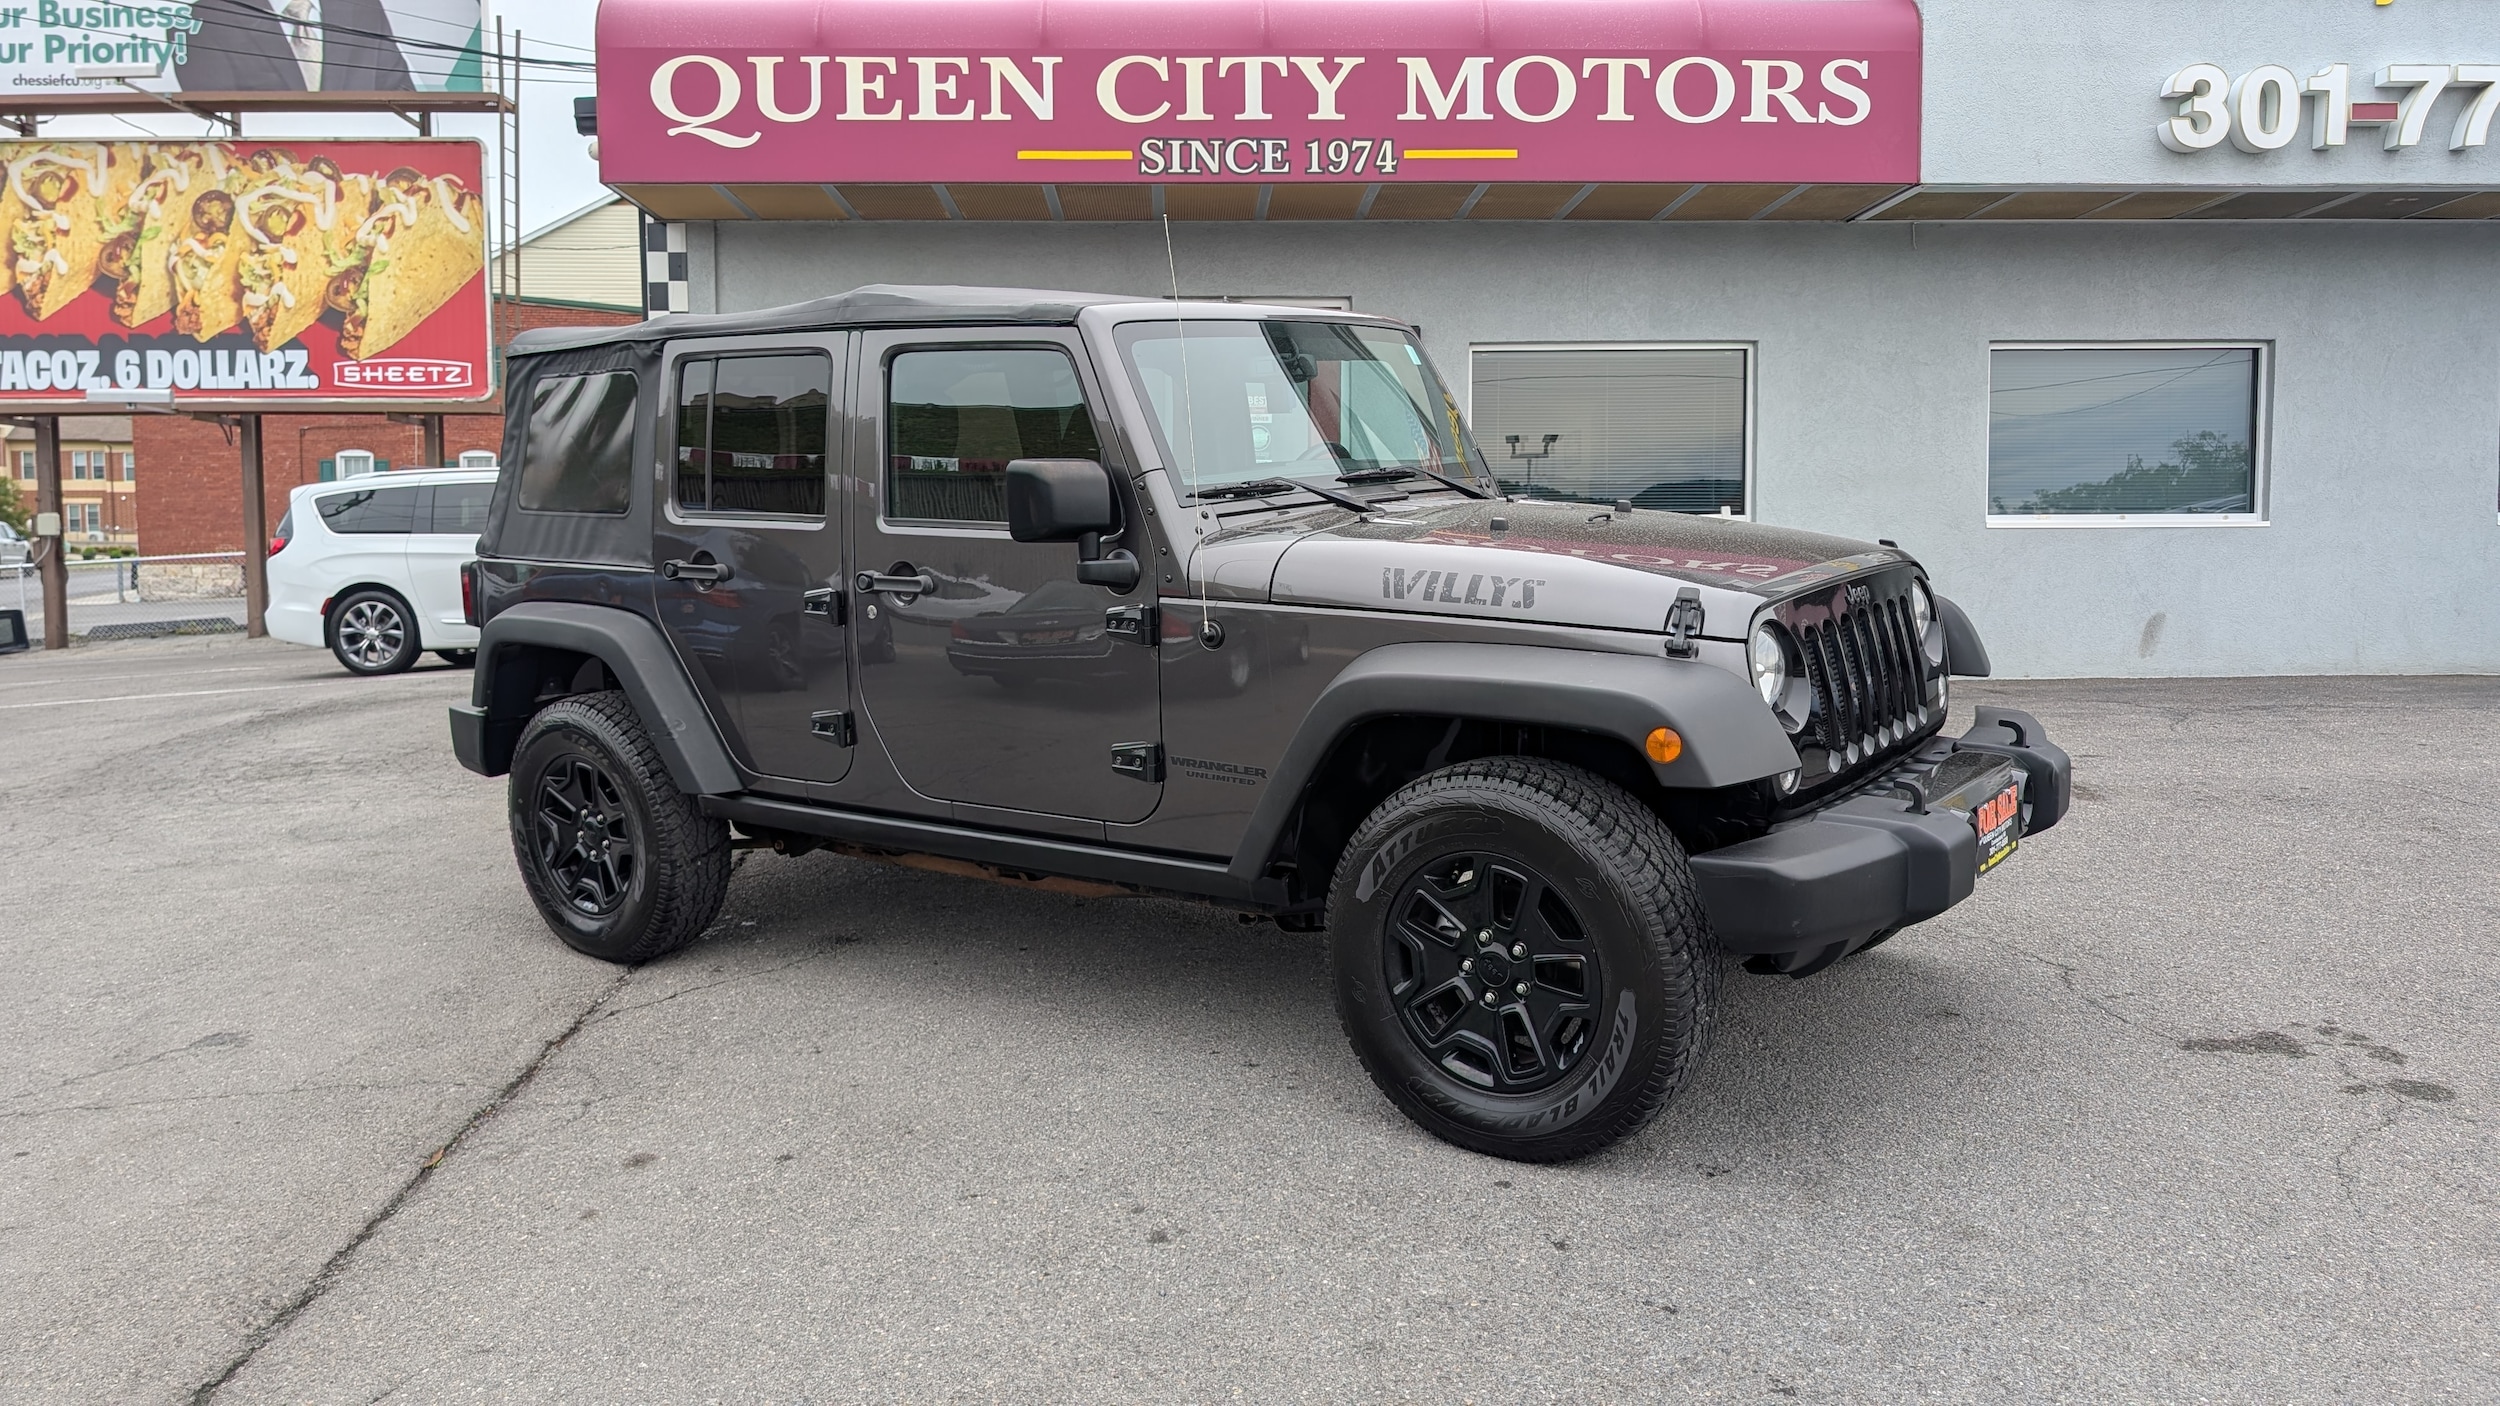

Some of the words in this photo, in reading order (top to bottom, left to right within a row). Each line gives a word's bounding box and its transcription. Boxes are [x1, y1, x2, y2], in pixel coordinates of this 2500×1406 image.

[39, 0, 204, 34] Business,
[44, 32, 188, 72] Priority!
[13, 74, 103, 89] chessiefcu.org
[649, 54, 1063, 149] QUEEN
[1096, 55, 1365, 123] CITY
[1396, 54, 1872, 126] MOTORS
[1139, 137, 1291, 175] SINCE
[1304, 137, 1398, 175] 1974
[0, 349, 111, 390] ACOZ.
[115, 349, 141, 389] 6
[146, 349, 319, 389] DOLLARZ.
[343, 366, 463, 382] SHEETZ
[1383, 567, 1547, 608] WILLYS
[1845, 584, 1870, 604] Jeep
[1170, 756, 1268, 779] WRANGLER
[1186, 770, 1256, 785] UNLIMITED
[1587, 1008, 1630, 1097] TRAIL
